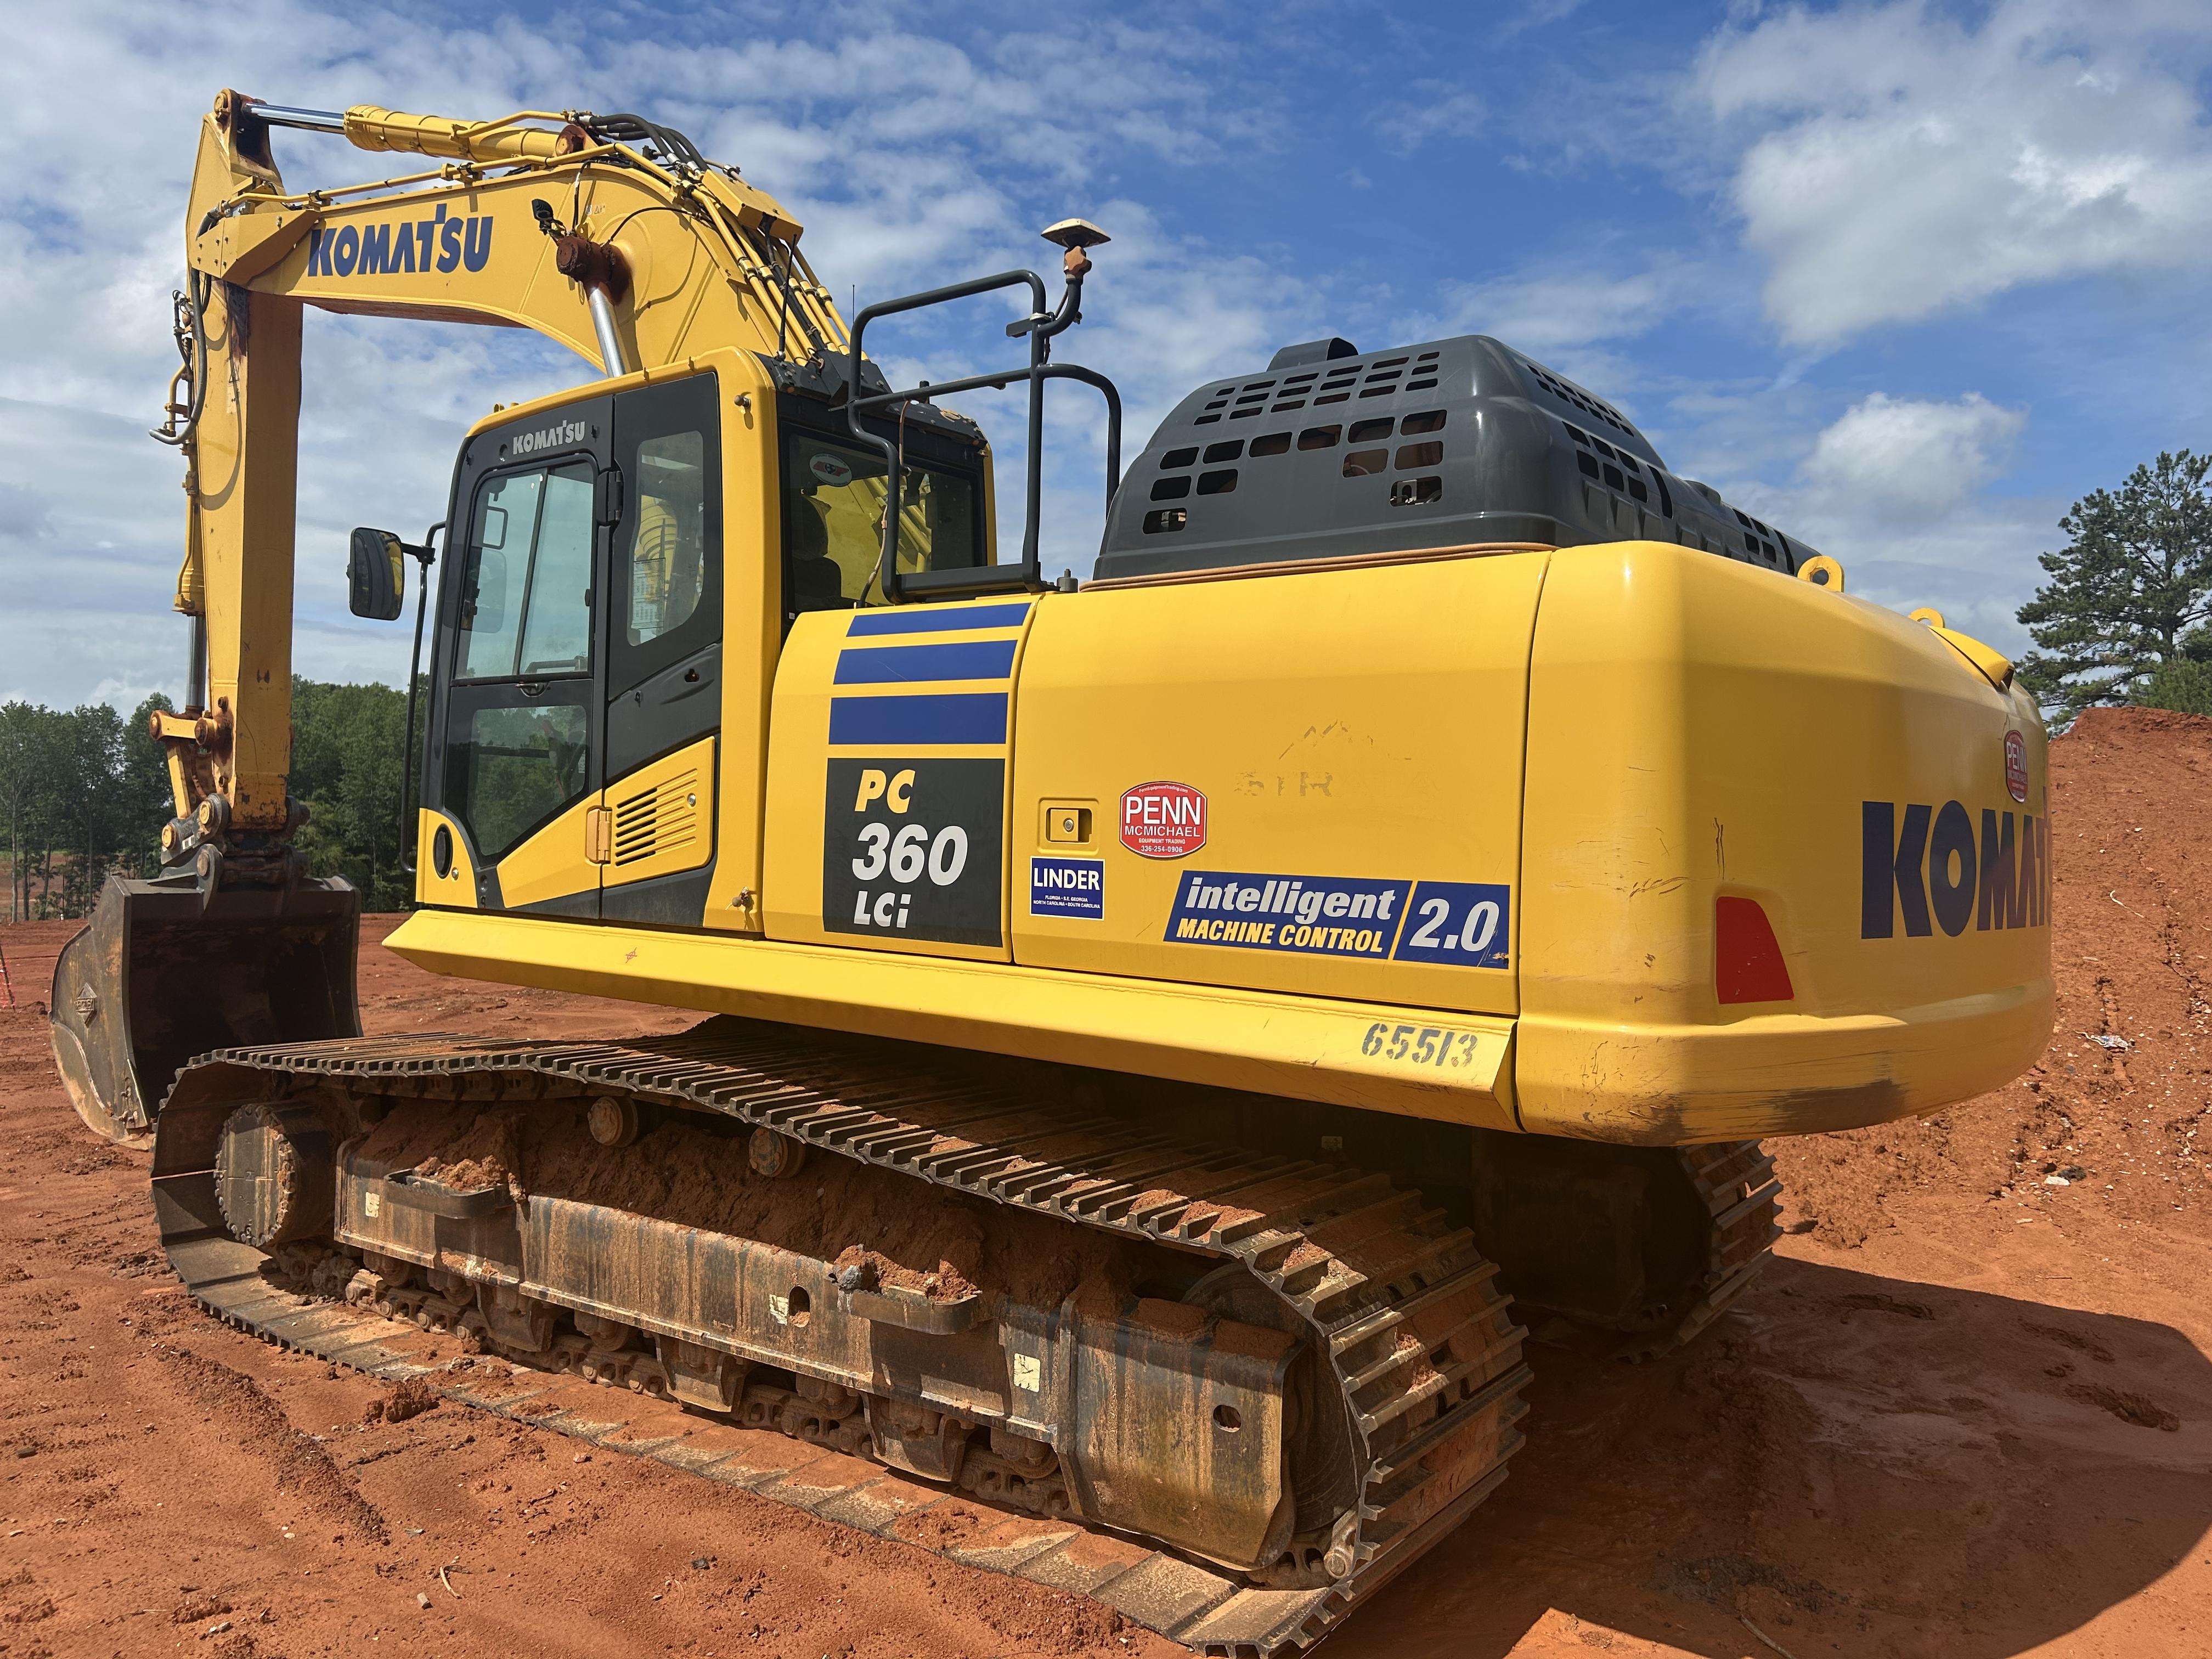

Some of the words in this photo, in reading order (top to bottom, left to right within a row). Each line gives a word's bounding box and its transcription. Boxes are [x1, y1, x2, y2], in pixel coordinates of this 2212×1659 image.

[308, 203, 494, 277] KOMATSU
[513, 420, 585, 455] KOMATSU
[854, 769, 916, 814] PC
[1125, 796, 1201, 825] PENN
[1125, 825, 1200, 837] MCMICHAEL
[852, 822, 968, 886] 360
[1861, 786, 2052, 939] KOMAT
[1034, 867, 1101, 890] LINDER
[1185, 877, 1396, 924] intelligent
[854, 890, 912, 928] LCi
[1409, 898, 1500, 952] 2.0
[1176, 918, 1276, 945] MACHINE
[1278, 924, 1384, 953] CONTROL
[1361, 1023, 1478, 1068] 65513
